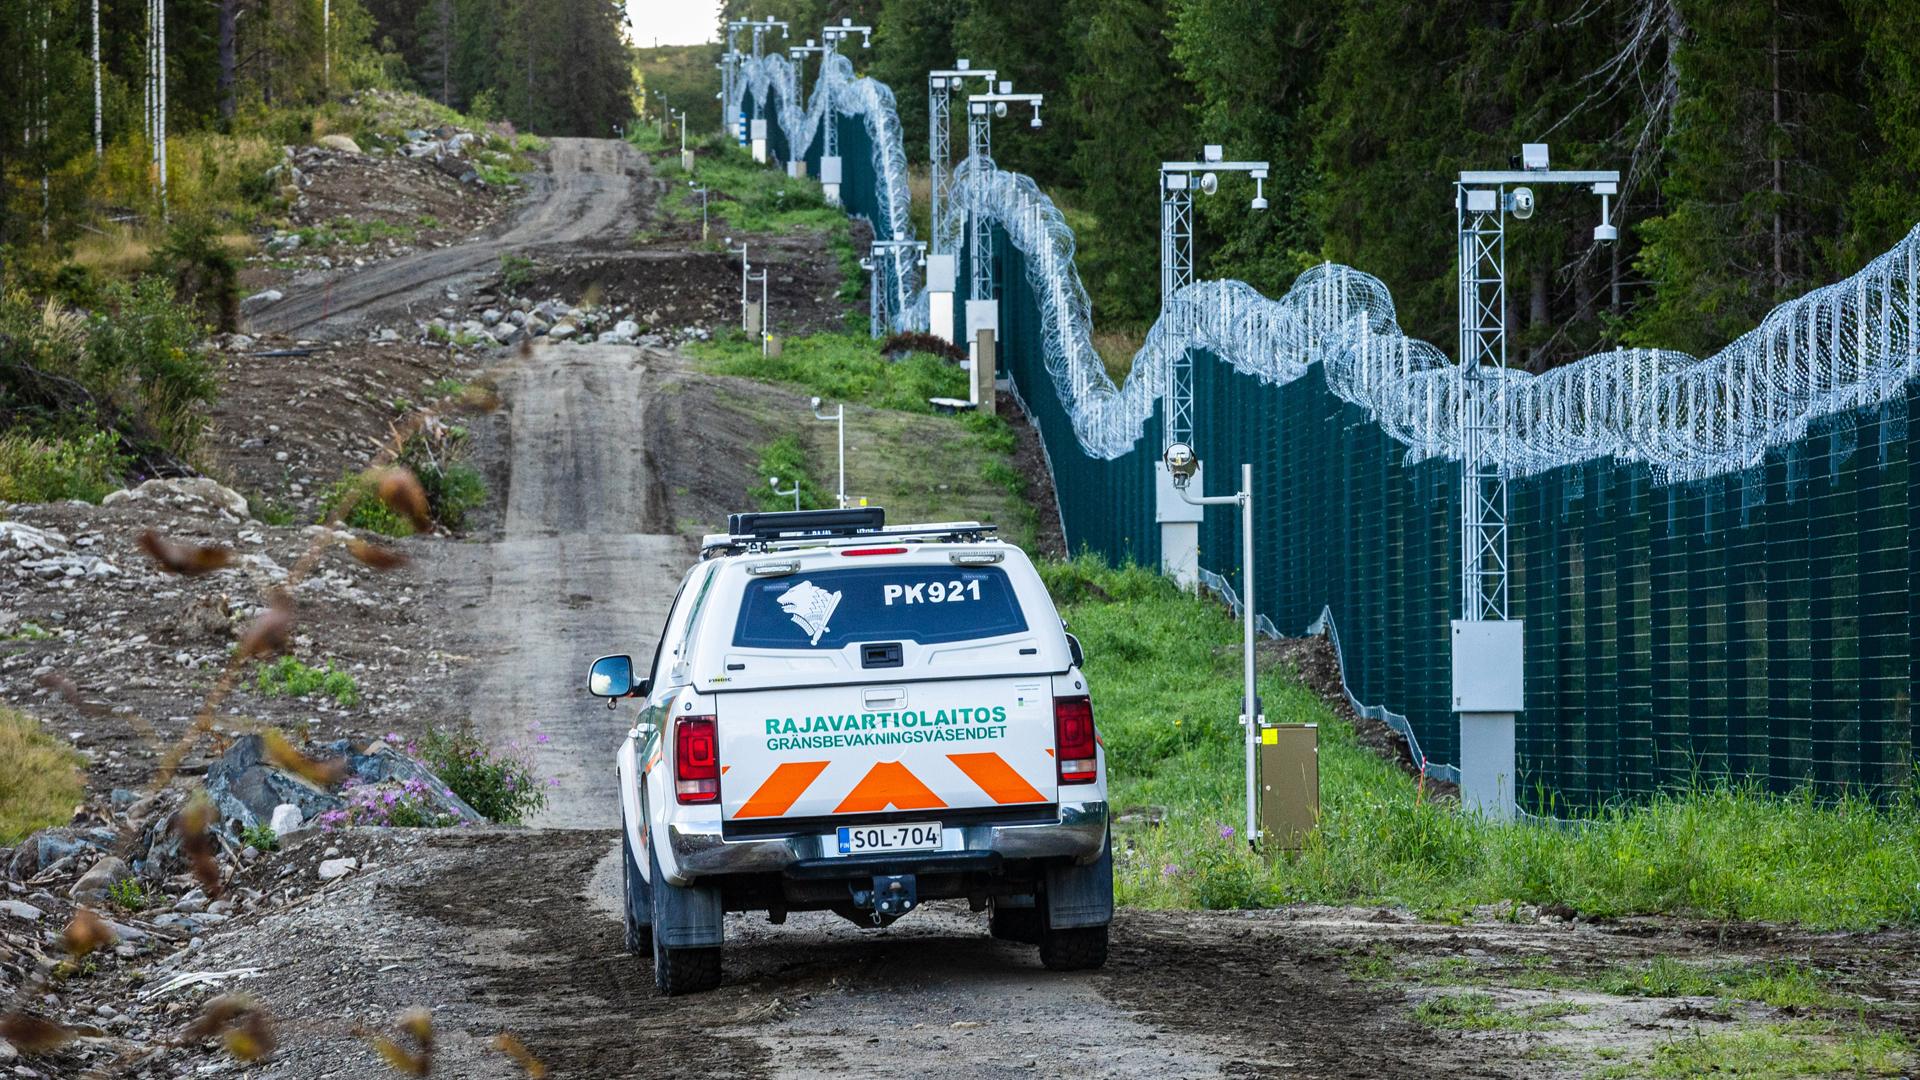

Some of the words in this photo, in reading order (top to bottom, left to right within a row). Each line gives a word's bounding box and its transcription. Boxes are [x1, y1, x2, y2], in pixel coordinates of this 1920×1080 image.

[883, 579, 982, 605] PK921
[766, 706, 1007, 735] RAJAVARTIOLAITOS
[767, 726, 1008, 751] GRÄNSBEVAKNINGSVÄSENDET
[854, 826, 938, 849] SOL-704
